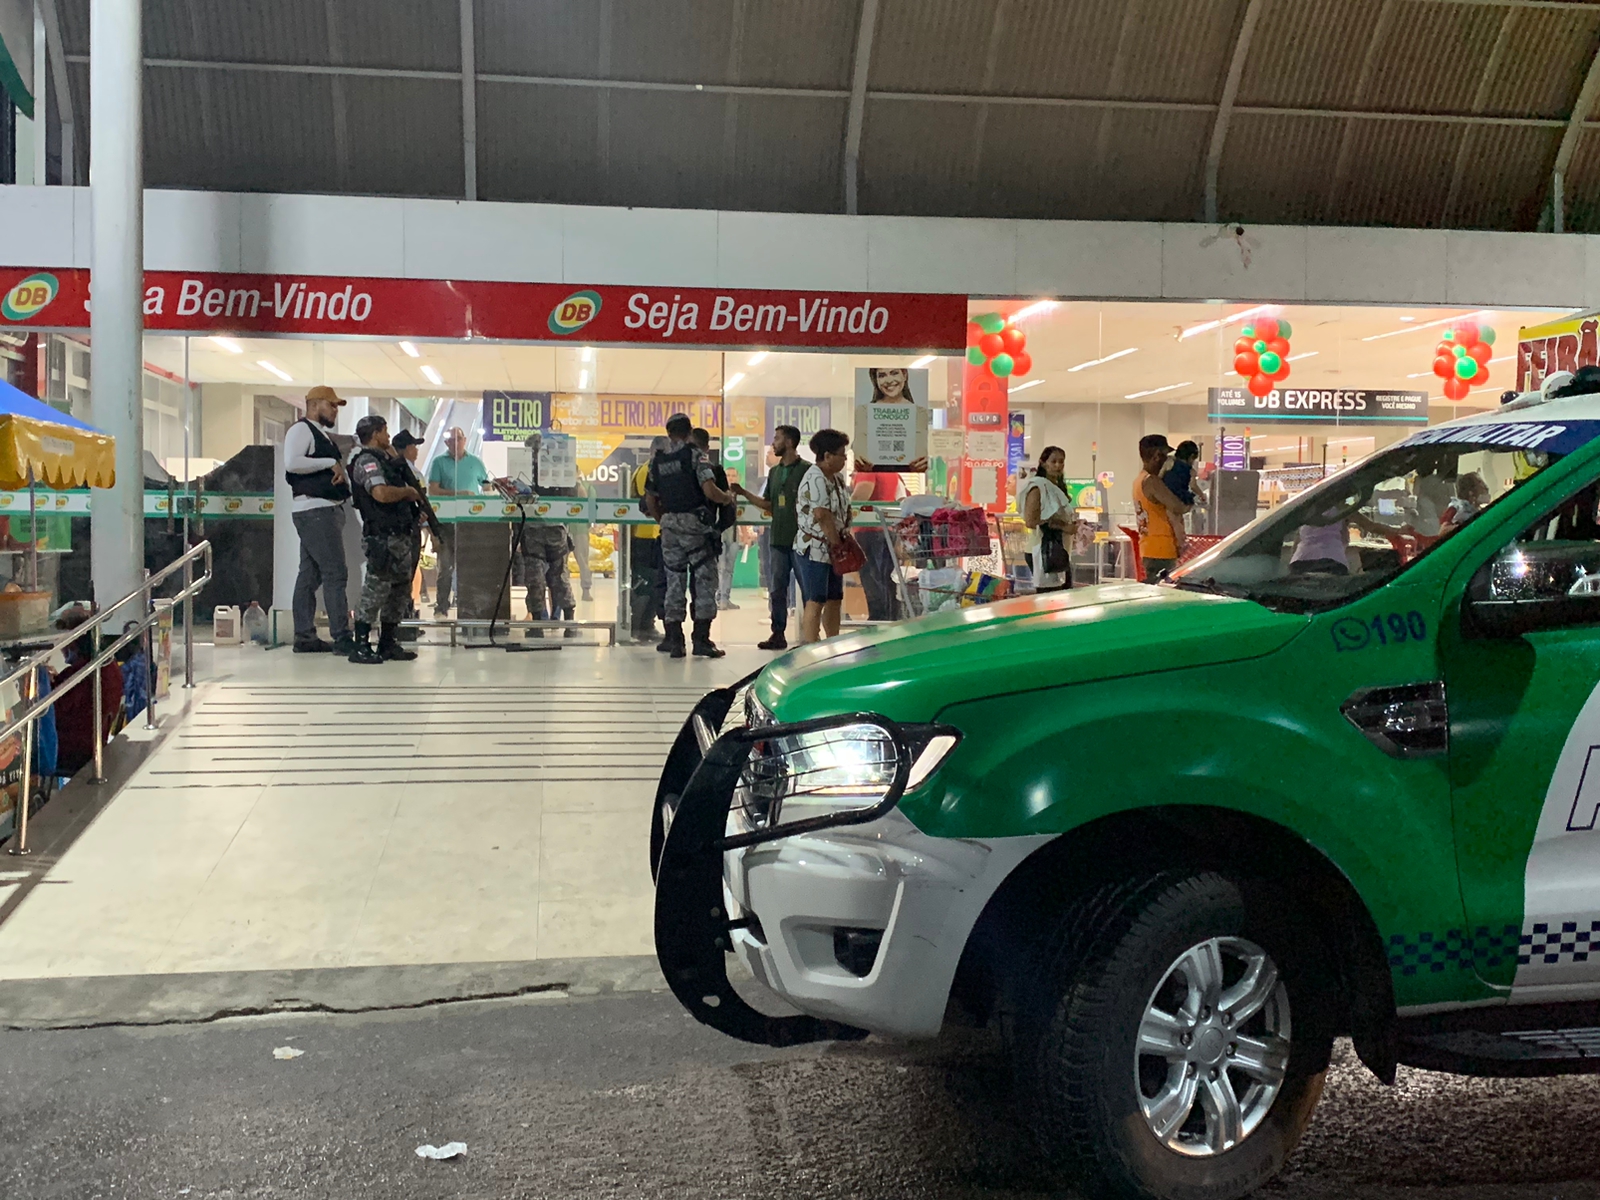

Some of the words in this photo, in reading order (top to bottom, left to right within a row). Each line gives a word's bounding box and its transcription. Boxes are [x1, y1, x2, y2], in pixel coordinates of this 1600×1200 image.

[15, 287, 48, 306] DB
[176, 279, 373, 322] Bem-Vindo
[560, 303, 593, 322] DB
[623, 292, 700, 337] Seja
[708, 296, 890, 334] Bem-Vindo
[1515, 319, 1600, 393] FEIRÃ
[1217, 398, 1246, 406] VOLUMES
[1220, 390, 1233, 398] ATÉ
[1254, 390, 1281, 409] DB
[1284, 390, 1367, 411] EXPRESS
[493, 398, 542, 428] ELETRO
[601, 400, 647, 428] ELETRO,
[773, 404, 821, 434] ELETRO
[873, 407, 910, 415] TRABALHE
[873, 413, 910, 421] CONOSCO
[1443, 423, 1567, 449] MILITAR
[1370, 610, 1427, 646] 190
